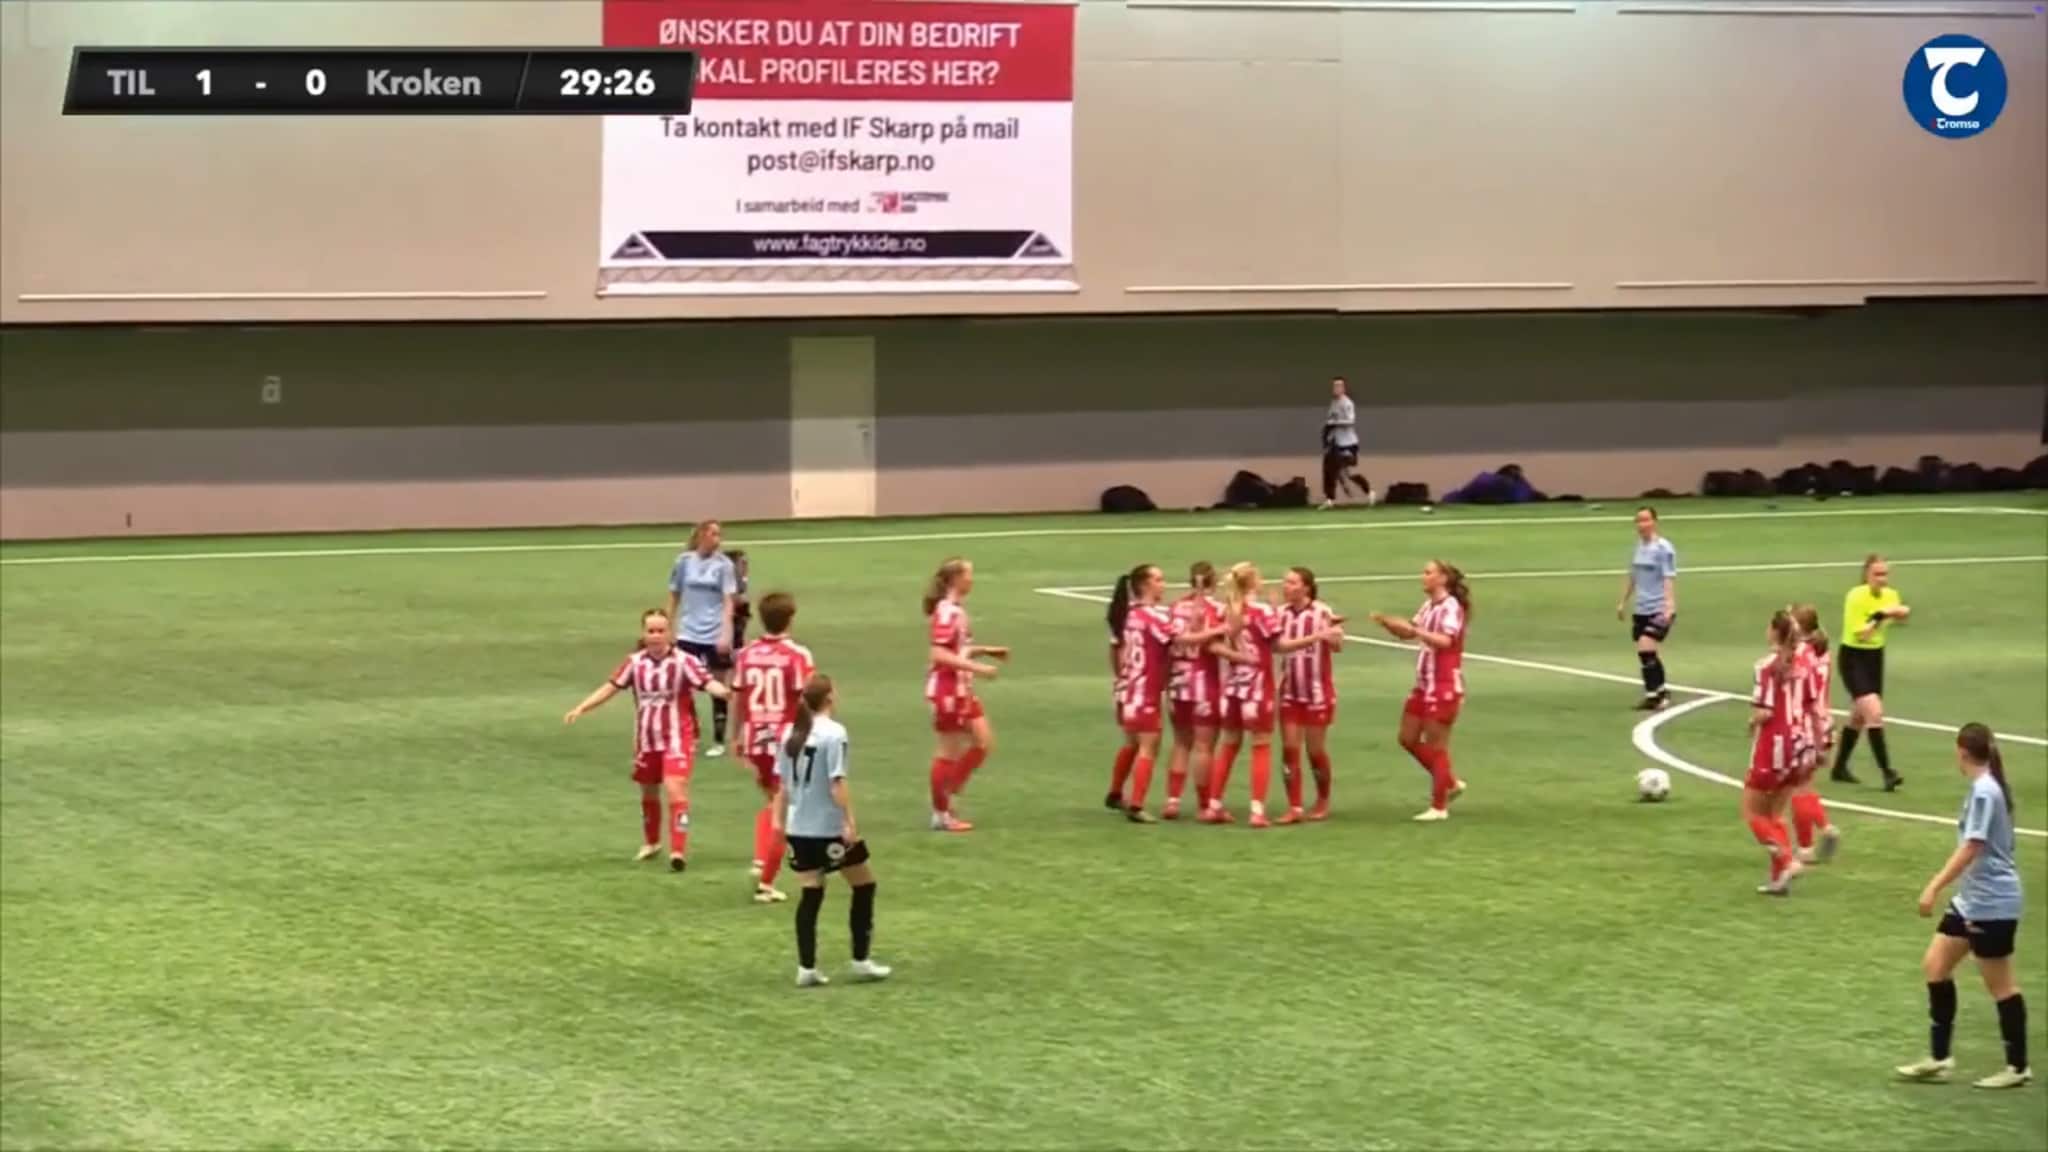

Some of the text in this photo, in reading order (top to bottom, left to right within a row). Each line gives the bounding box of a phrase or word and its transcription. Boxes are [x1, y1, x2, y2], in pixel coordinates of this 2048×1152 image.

[659, 19, 1022, 48] ØNSKER DU AT DIN BEDRIFT
[696, 58, 1000, 86] KAL PROFILERES HER?
[660, 114, 1020, 144] Ta kontakt med IF Skarp på mail
[747, 149, 935, 176] post@ifskarp.no
[744, 199, 824, 213] samarbeid
[827, 200, 860, 213] med
[753, 233, 927, 256] www.fagtrykkide.no
[744, 667, 786, 713] 20
